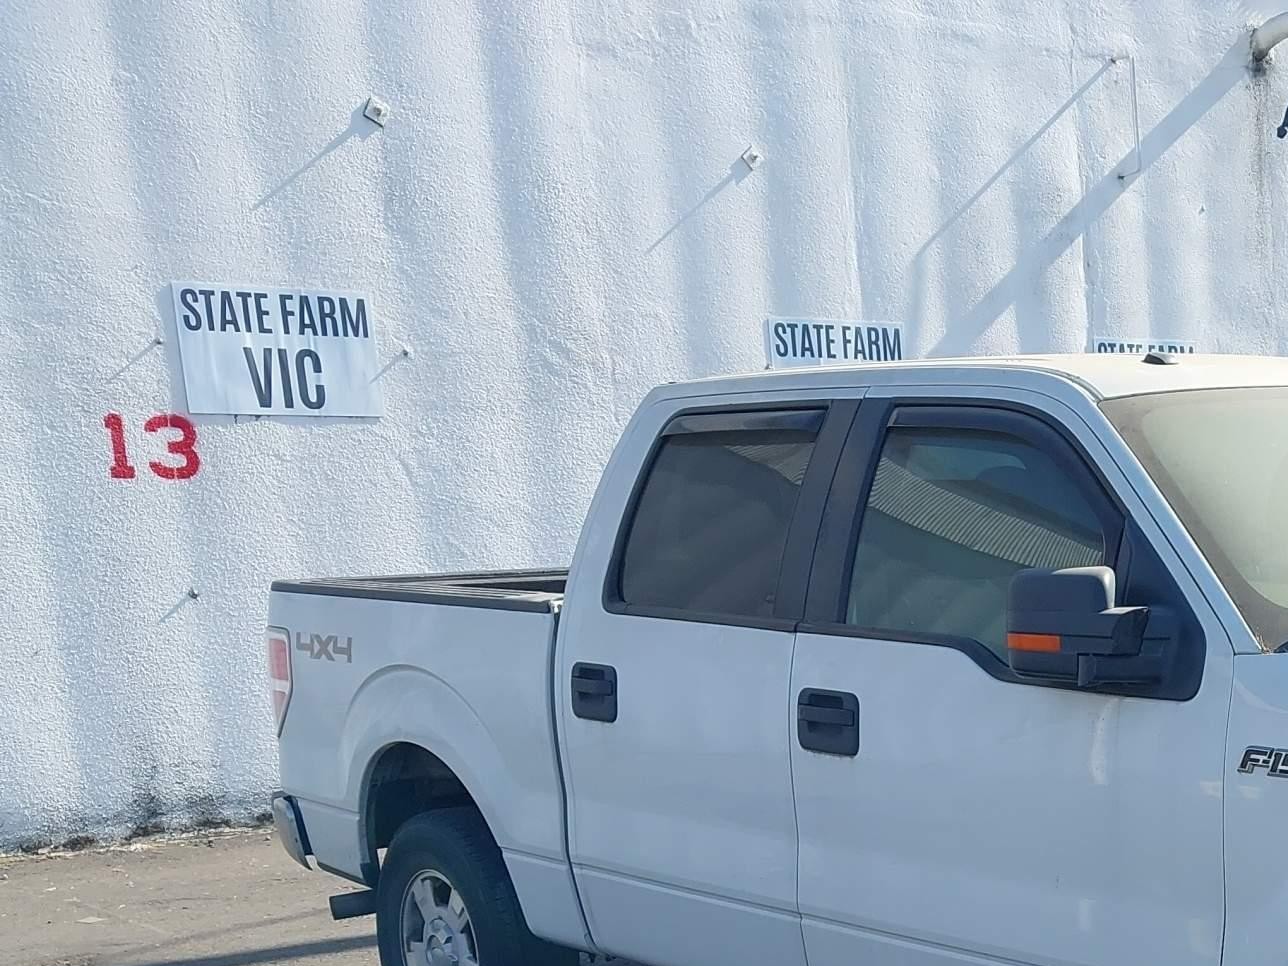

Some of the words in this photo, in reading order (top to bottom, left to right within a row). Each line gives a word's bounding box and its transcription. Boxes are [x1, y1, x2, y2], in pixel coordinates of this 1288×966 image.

[180, 288, 273, 334] STATE
[279, 294, 369, 338] FARM
[773, 322, 836, 359] STATE
[841, 325, 902, 361] FARM
[243, 347, 326, 410] VIC
[103, 413, 200, 480] 13
